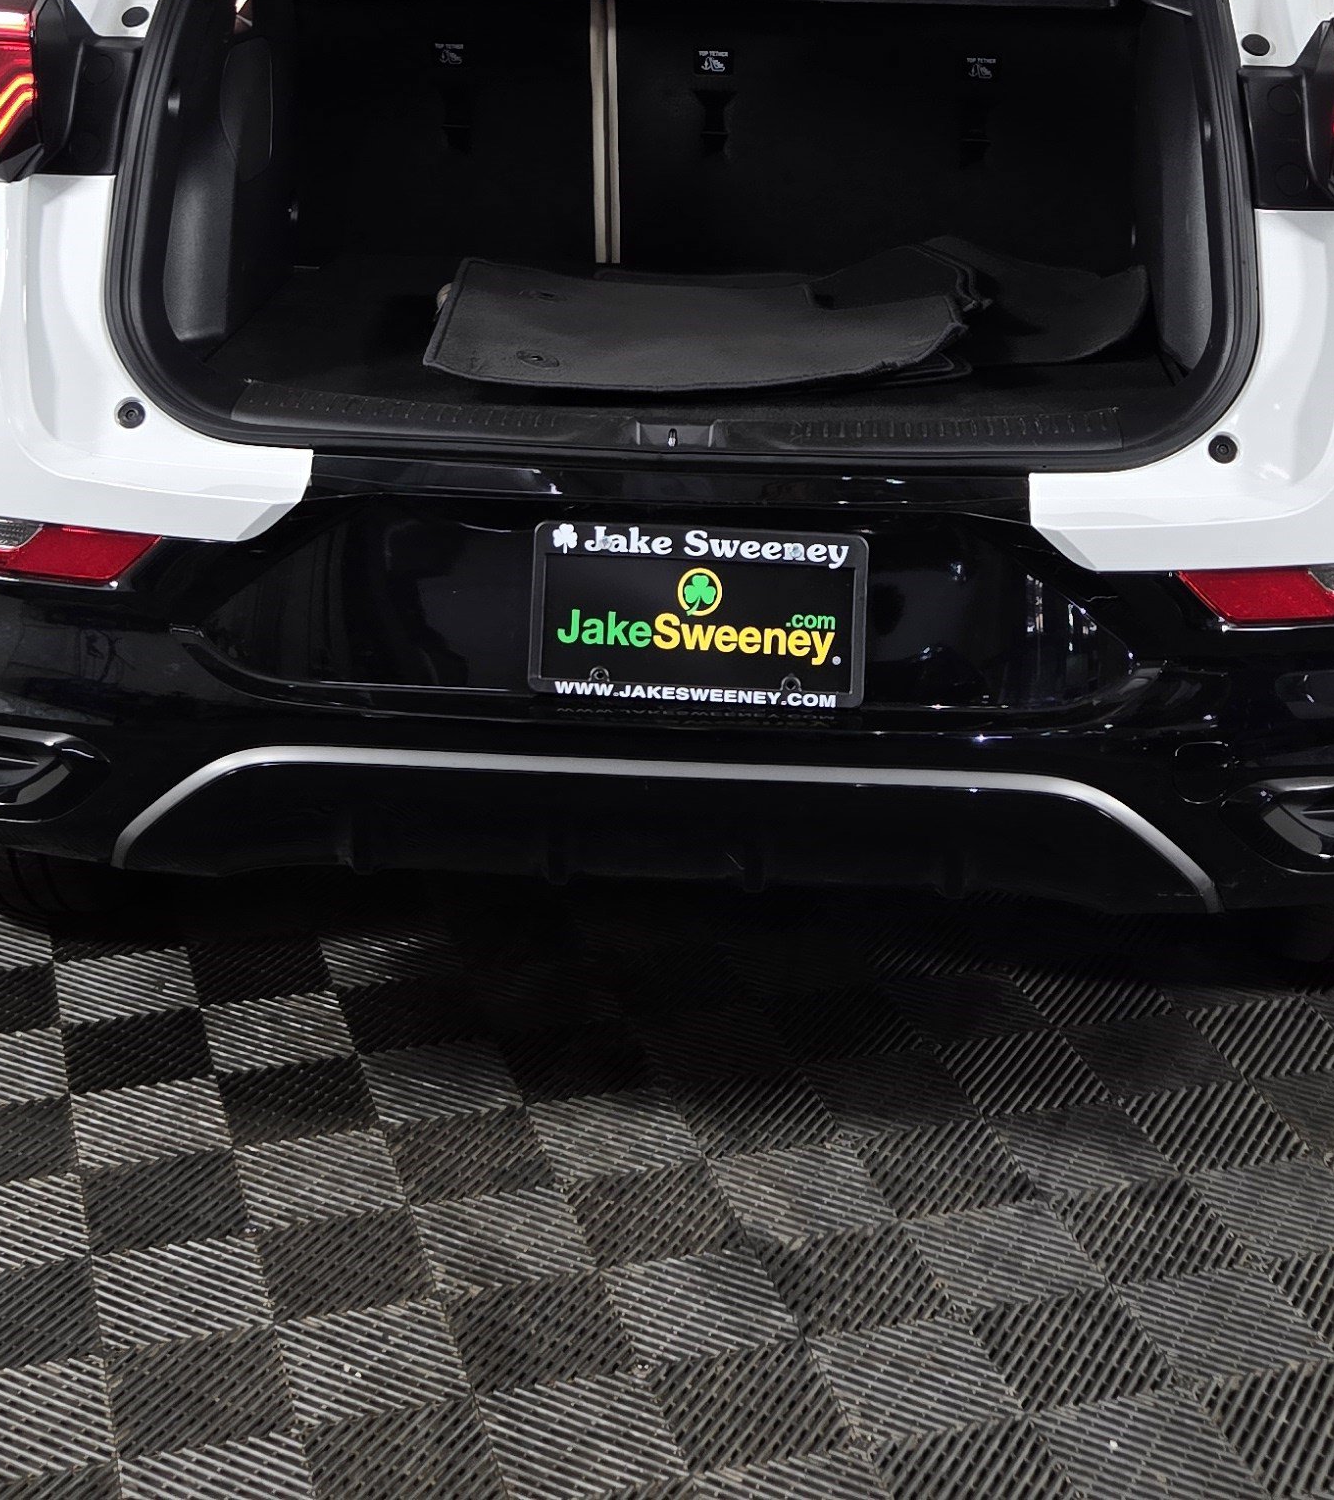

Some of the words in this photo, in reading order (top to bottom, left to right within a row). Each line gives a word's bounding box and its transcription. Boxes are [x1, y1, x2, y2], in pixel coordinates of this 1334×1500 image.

[584, 525, 673, 554] Jake
[683, 529, 850, 569] Sweeney
[554, 680, 837, 708] WWW.JAKESWEENEY.COM
